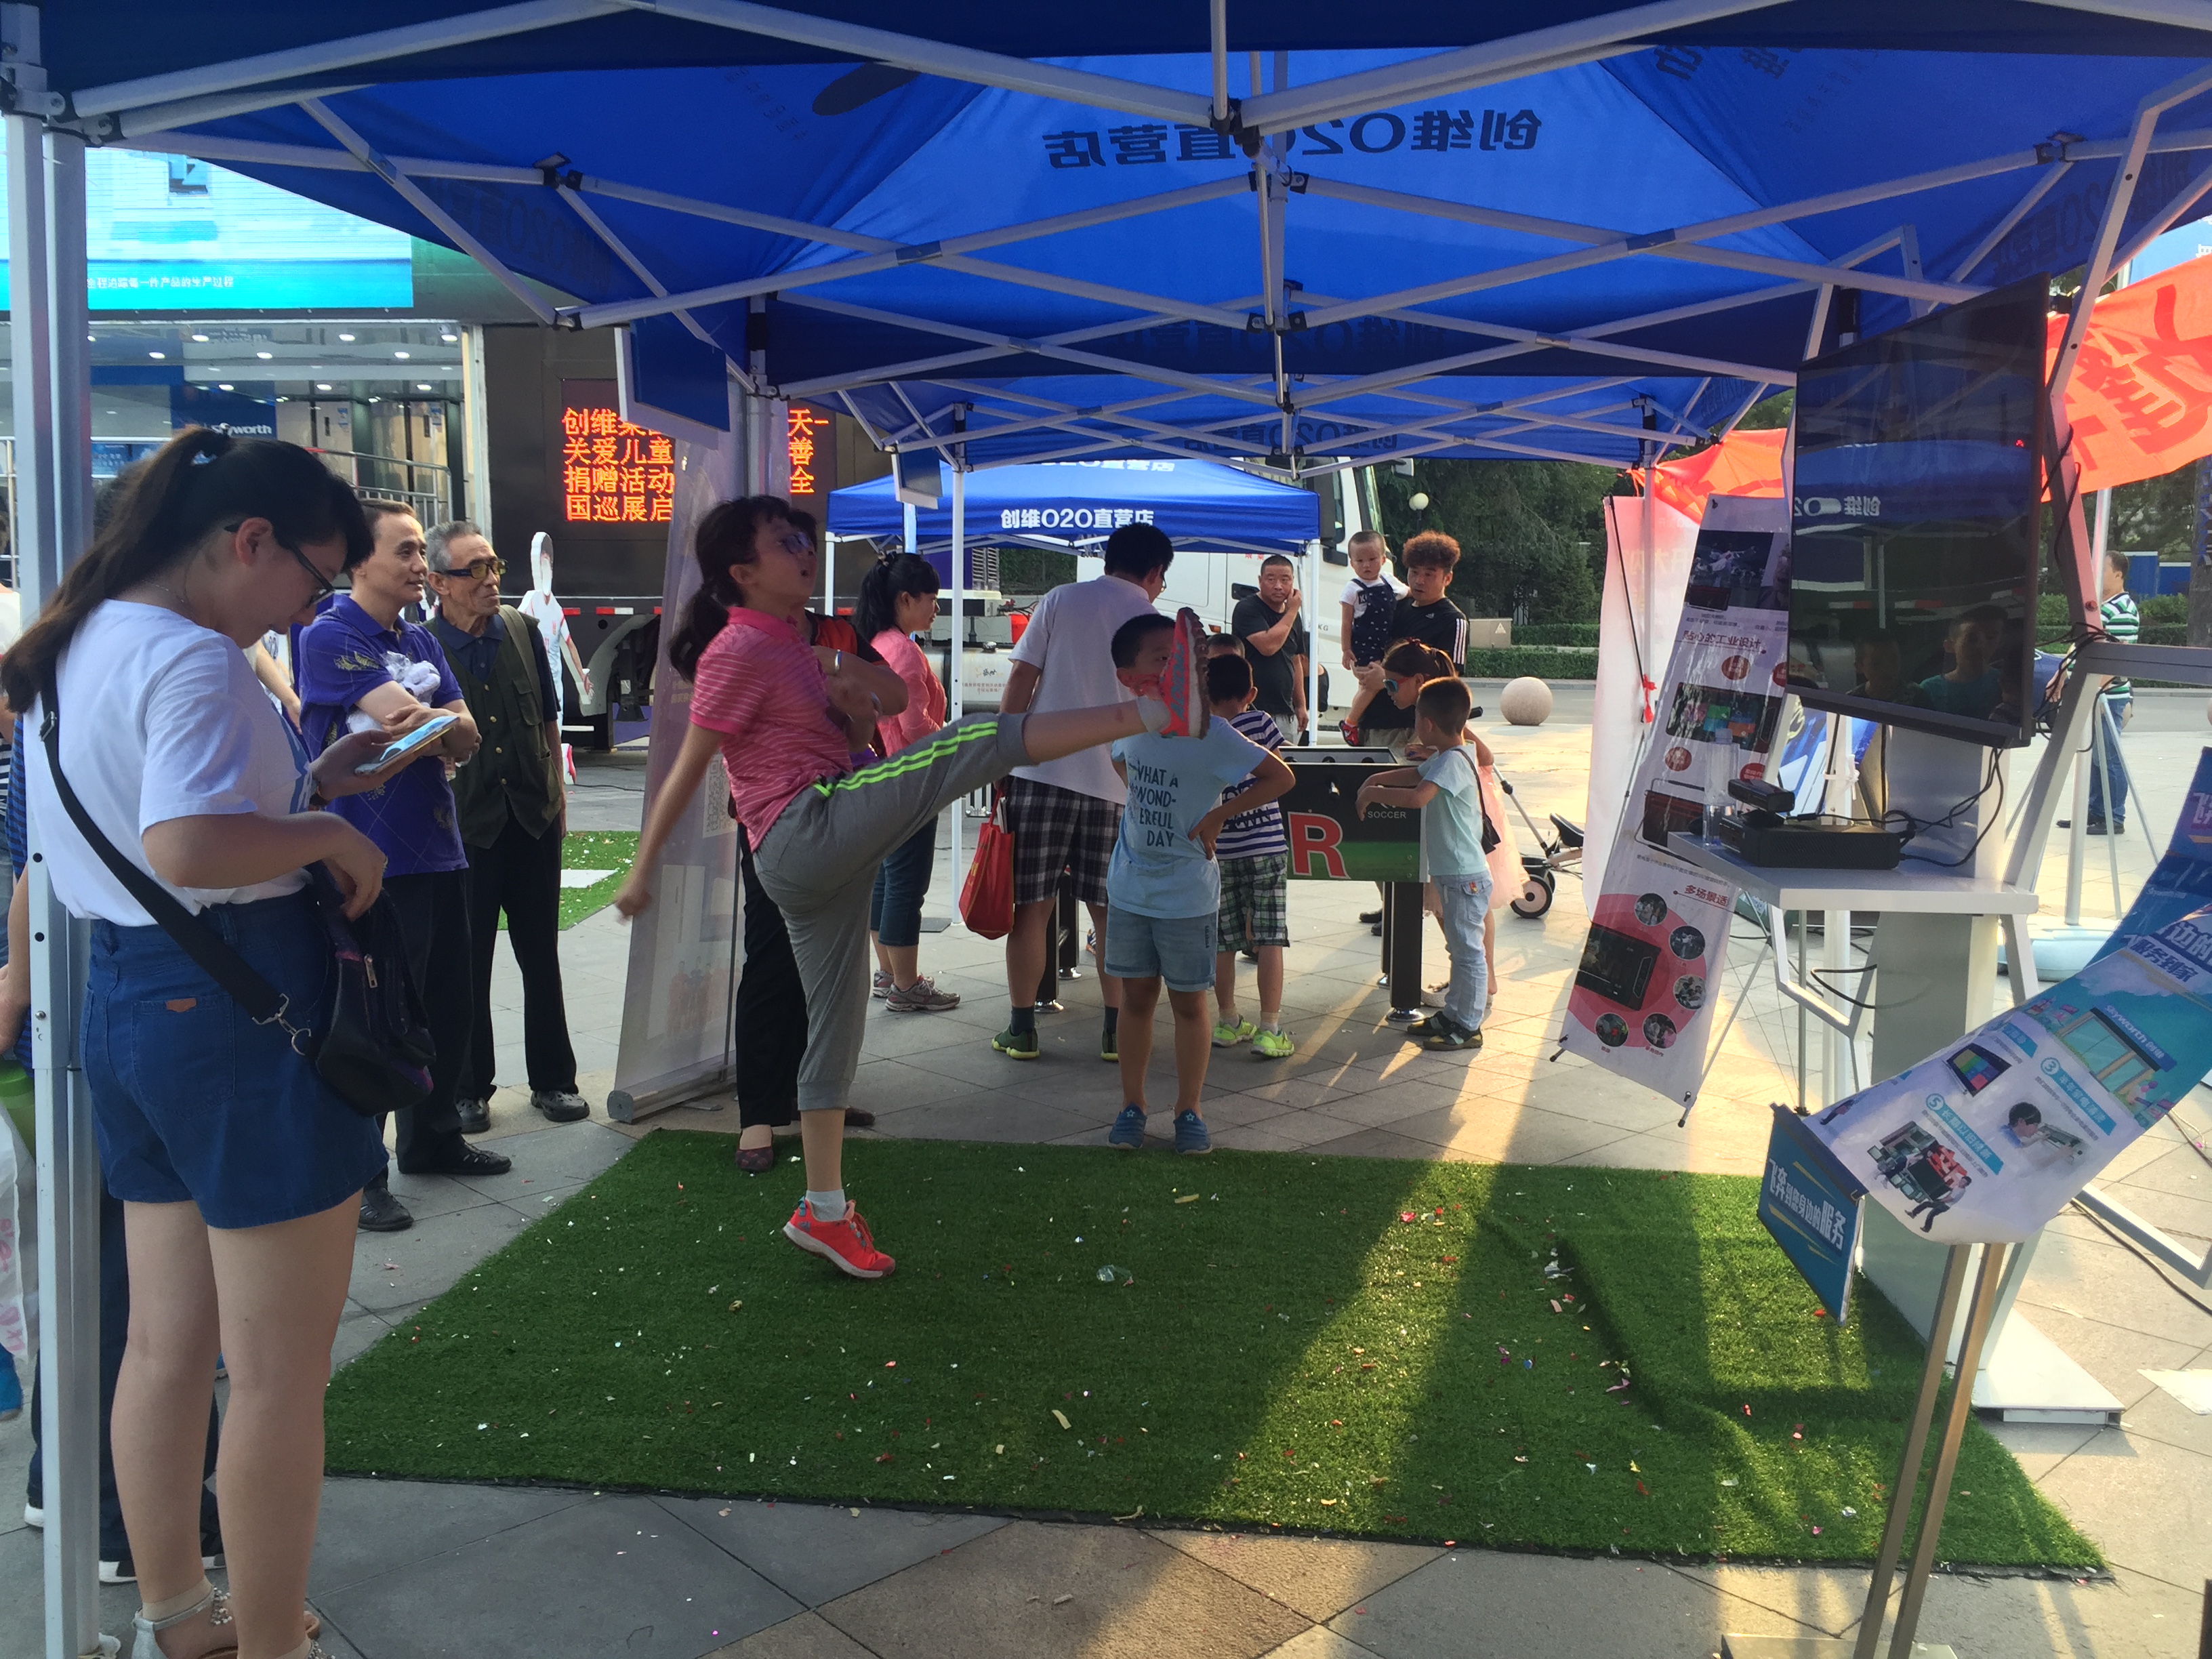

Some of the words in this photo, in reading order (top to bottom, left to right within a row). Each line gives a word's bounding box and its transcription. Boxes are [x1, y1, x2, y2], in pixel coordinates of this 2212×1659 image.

[562, 407, 662, 436] 创维
[563, 436, 674, 465] 关爱儿童
[563, 464, 675, 494] 捐赠活动
[566, 494, 674, 522] 国巡展启
[1000, 508, 1154, 529] 创维O2O直营店
[1169, 775, 1179, 788] A
[1139, 807, 1174, 830] ERFUL
[1367, 811, 1407, 819] SOCCER
[1147, 830, 1174, 847] DAY
